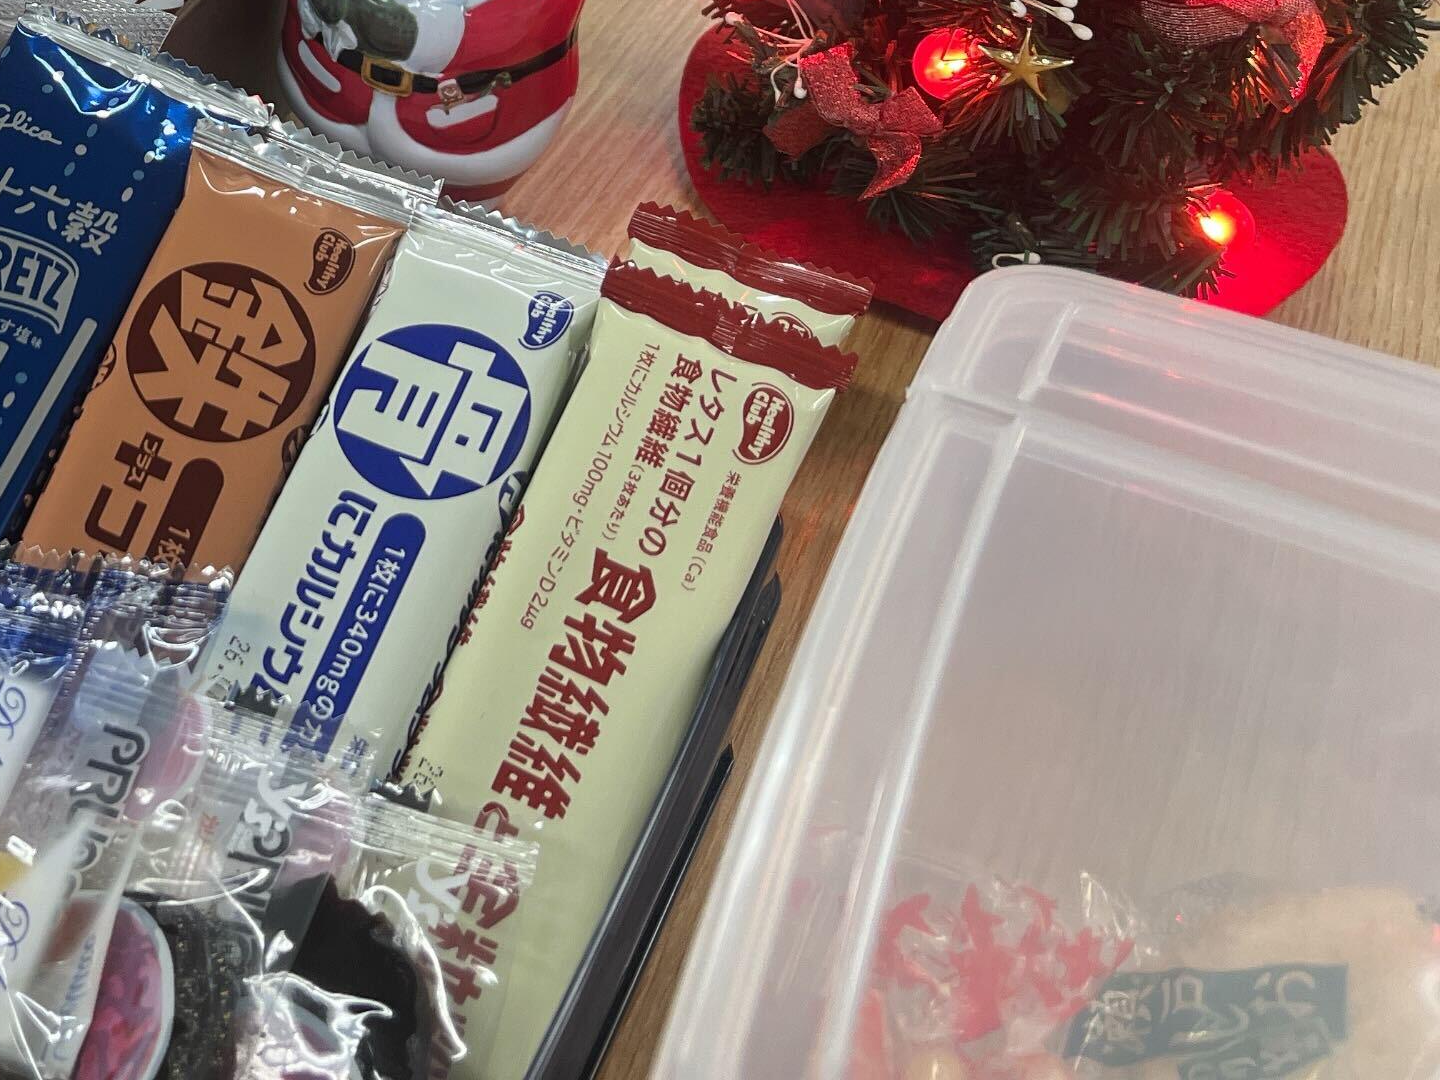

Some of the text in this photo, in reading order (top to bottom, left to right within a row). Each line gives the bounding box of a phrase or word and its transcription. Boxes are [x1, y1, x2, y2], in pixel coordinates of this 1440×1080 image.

[315, 232, 335, 262] Club
[319, 237, 348, 289] Healthy
[337, 341, 529, 495] 骨
[745, 389, 770, 425] Club
[747, 395, 787, 459] Healthy
[639, 368, 738, 556] レタス1個分の
